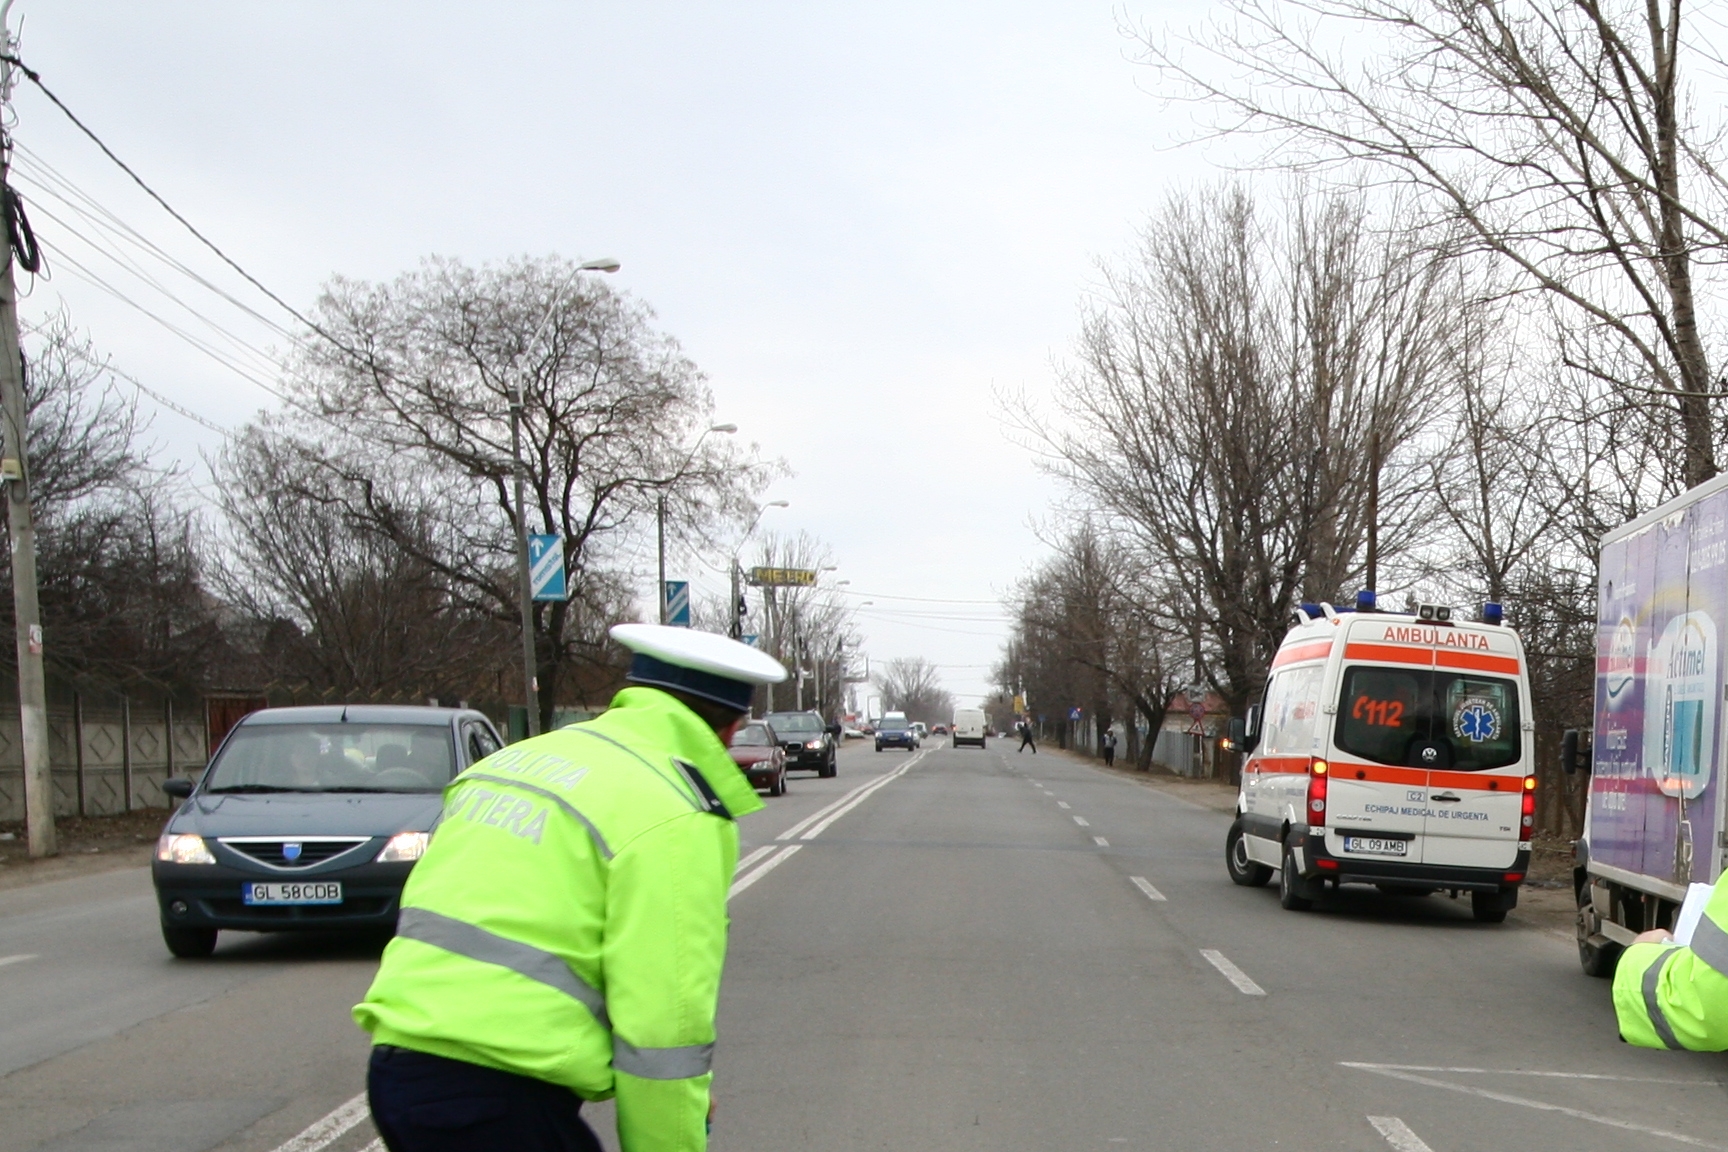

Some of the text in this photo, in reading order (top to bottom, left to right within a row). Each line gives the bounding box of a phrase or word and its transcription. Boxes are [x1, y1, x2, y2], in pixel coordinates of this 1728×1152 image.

[1383, 626, 1489, 650] AMBULANTA
[1666, 637, 1707, 679] Actimel
[1364, 700, 1404, 727] 112
[1409, 792, 1423, 801] C2
[441, 786, 548, 846] UTIERA
[1364, 803, 1489, 821] ECHIPAJ MEDICAL DE URGENTA
[1351, 838, 1405, 852] GL 09 AMB
[254, 885, 275, 900] GL
